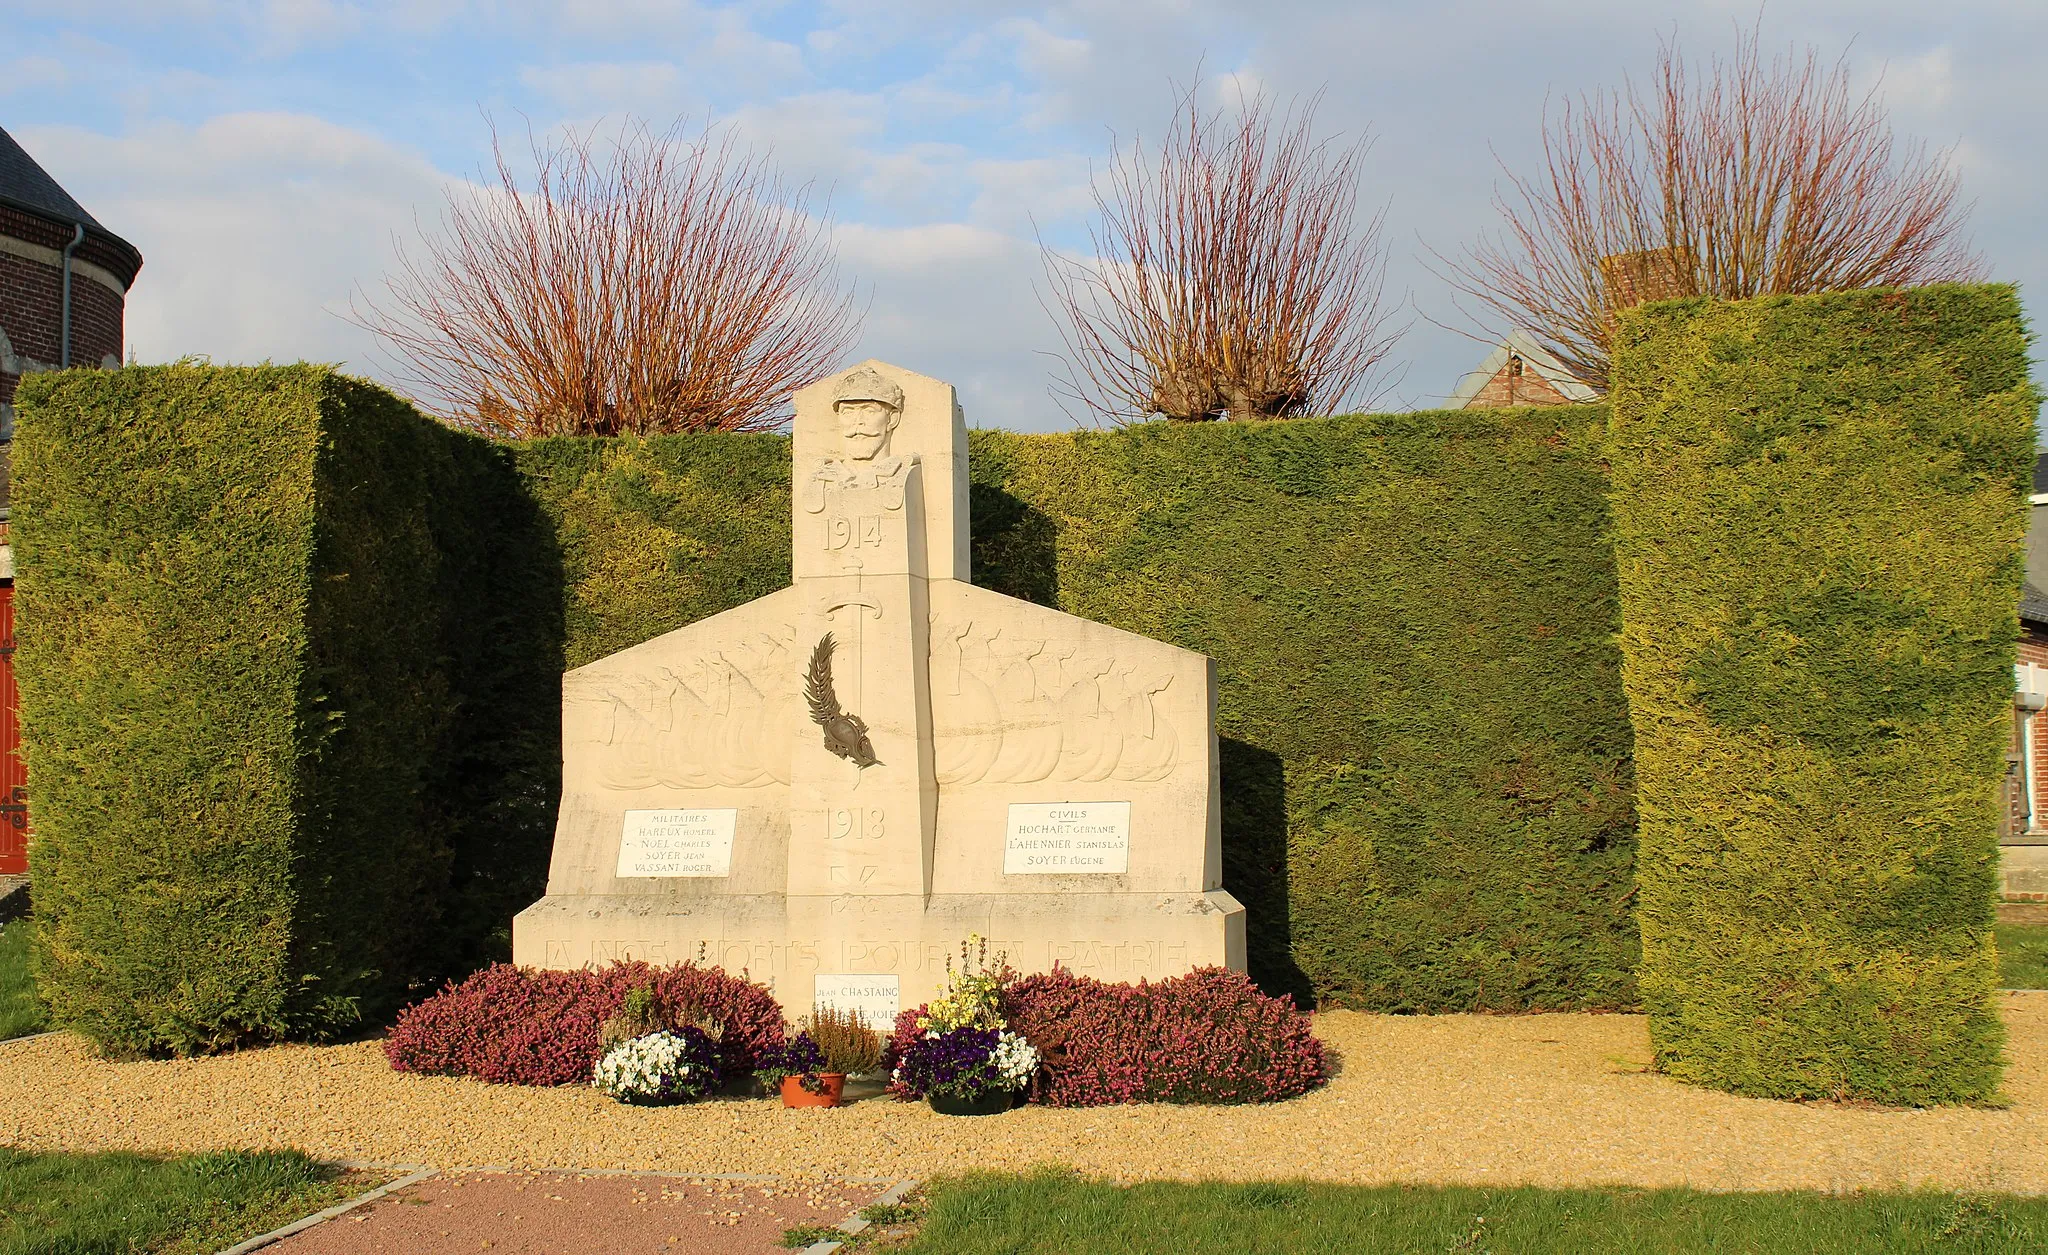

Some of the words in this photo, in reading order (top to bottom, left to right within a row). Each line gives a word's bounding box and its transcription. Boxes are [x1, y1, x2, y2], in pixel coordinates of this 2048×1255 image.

[823, 513, 883, 551] 1914
[651, 815, 708, 823] MILITAIRES
[1049, 810, 1088, 819] CIVILS
[823, 807, 885, 839] 1918
[638, 827, 681, 837] HAREUX
[1018, 825, 1072, 834] HOCHART
[674, 840, 711, 848] CHARLES
[1075, 841, 1125, 849] STANISLAS
[645, 851, 681, 860] SOYER
[683, 852, 705, 860] JEAN
[1026, 855, 1067, 865] SOYER
[634, 863, 680, 872] VASSANT
[682, 864, 712, 872] ROGER
[590, 939, 670, 969] NOS
[689, 939, 821, 971] MORTS
[841, 939, 948, 972] POUR
[1047, 939, 1188, 973] PATRIE
[816, 989, 836, 997] JEAN
[841, 987, 898, 997] CHASTAING
